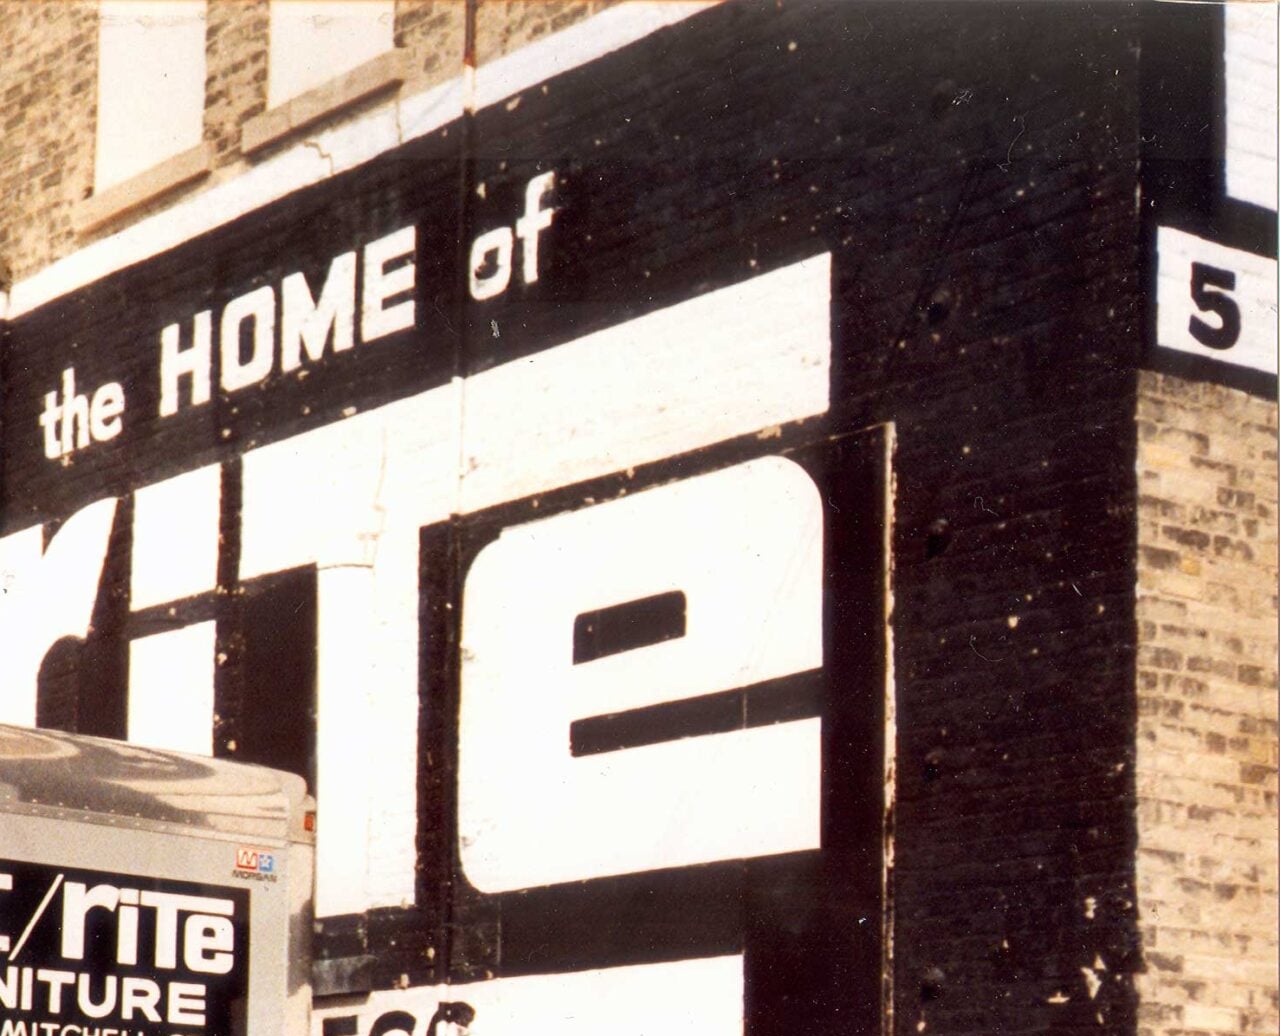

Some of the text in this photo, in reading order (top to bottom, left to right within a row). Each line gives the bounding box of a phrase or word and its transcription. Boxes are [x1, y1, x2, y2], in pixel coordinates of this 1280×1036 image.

[39, 172, 558, 460] the HOME of
